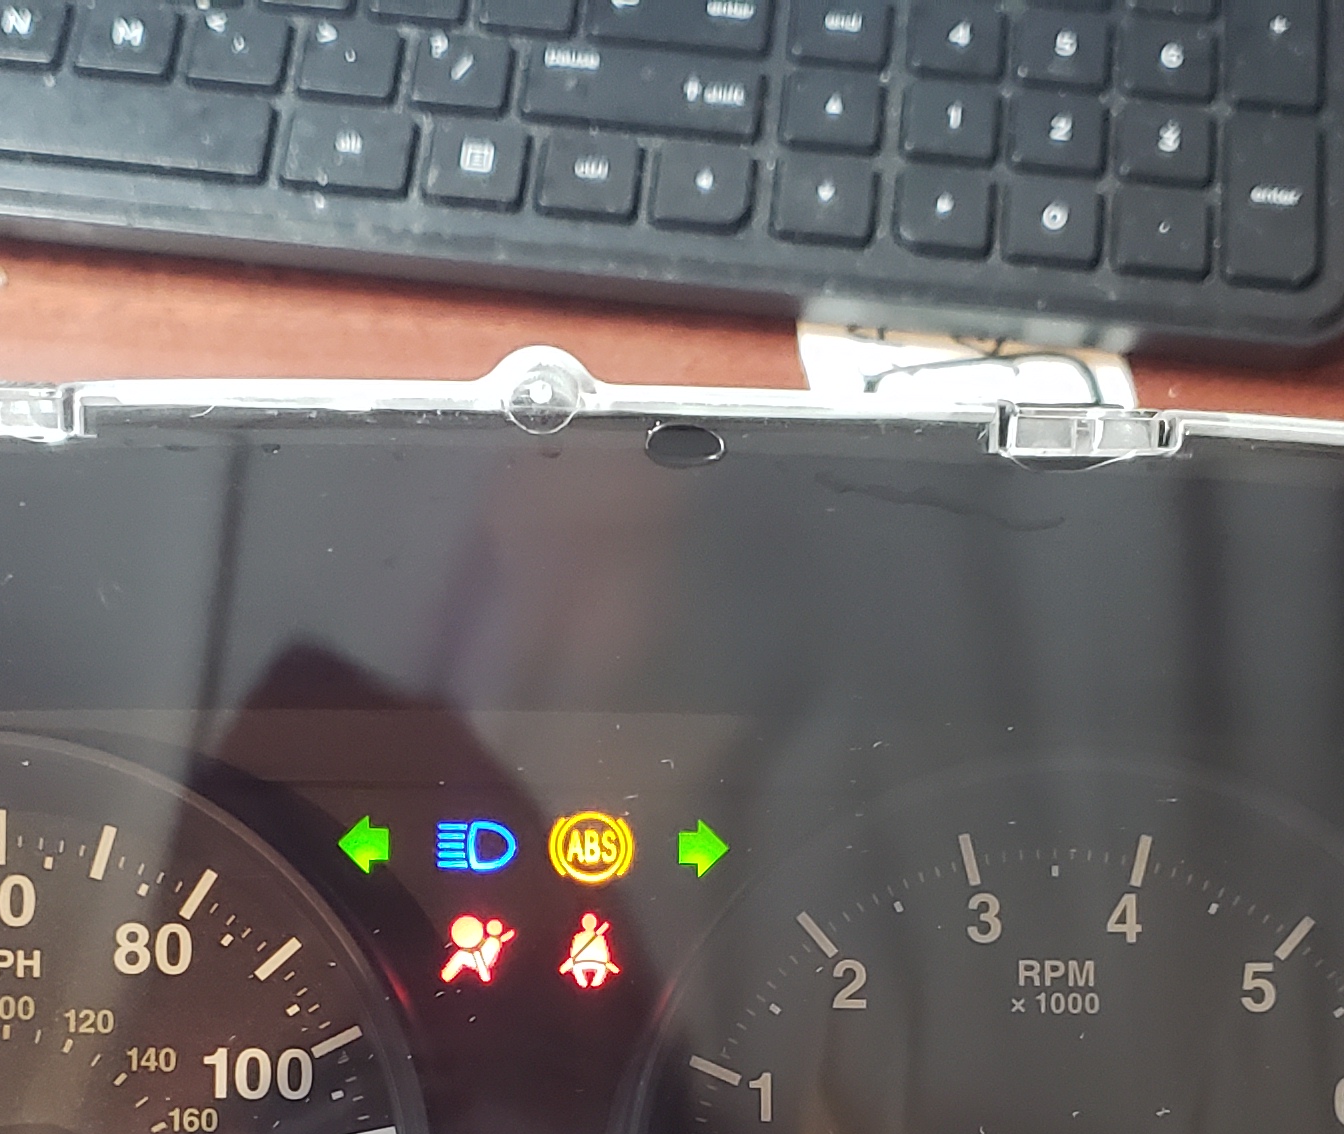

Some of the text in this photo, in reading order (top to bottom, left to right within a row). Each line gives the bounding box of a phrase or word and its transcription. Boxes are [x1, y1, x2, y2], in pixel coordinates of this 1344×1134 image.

[0, 5, 34, 35] N
[111, 17, 145, 47] M
[947, 20, 973, 48] 4
[1055, 29, 1078, 58] 5
[946, 101, 963, 130] 1
[1049, 112, 1073, 142] 2
[565, 828, 618, 865] ABS
[966, 892, 1003, 944] 3
[1106, 892, 1143, 943] 4
[112, 921, 194, 976] 80
[831, 959, 868, 1010] 2
[1017, 959, 1096, 988] RPM
[1240, 962, 1277, 1013] 5
[1035, 992, 1101, 1015] 1000
[63, 1008, 115, 1035] 120
[126, 1046, 177, 1073] 140
[203, 1046, 313, 1101] 100
[748, 1071, 773, 1123] 1
[167, 1106, 219, 1133] 160
